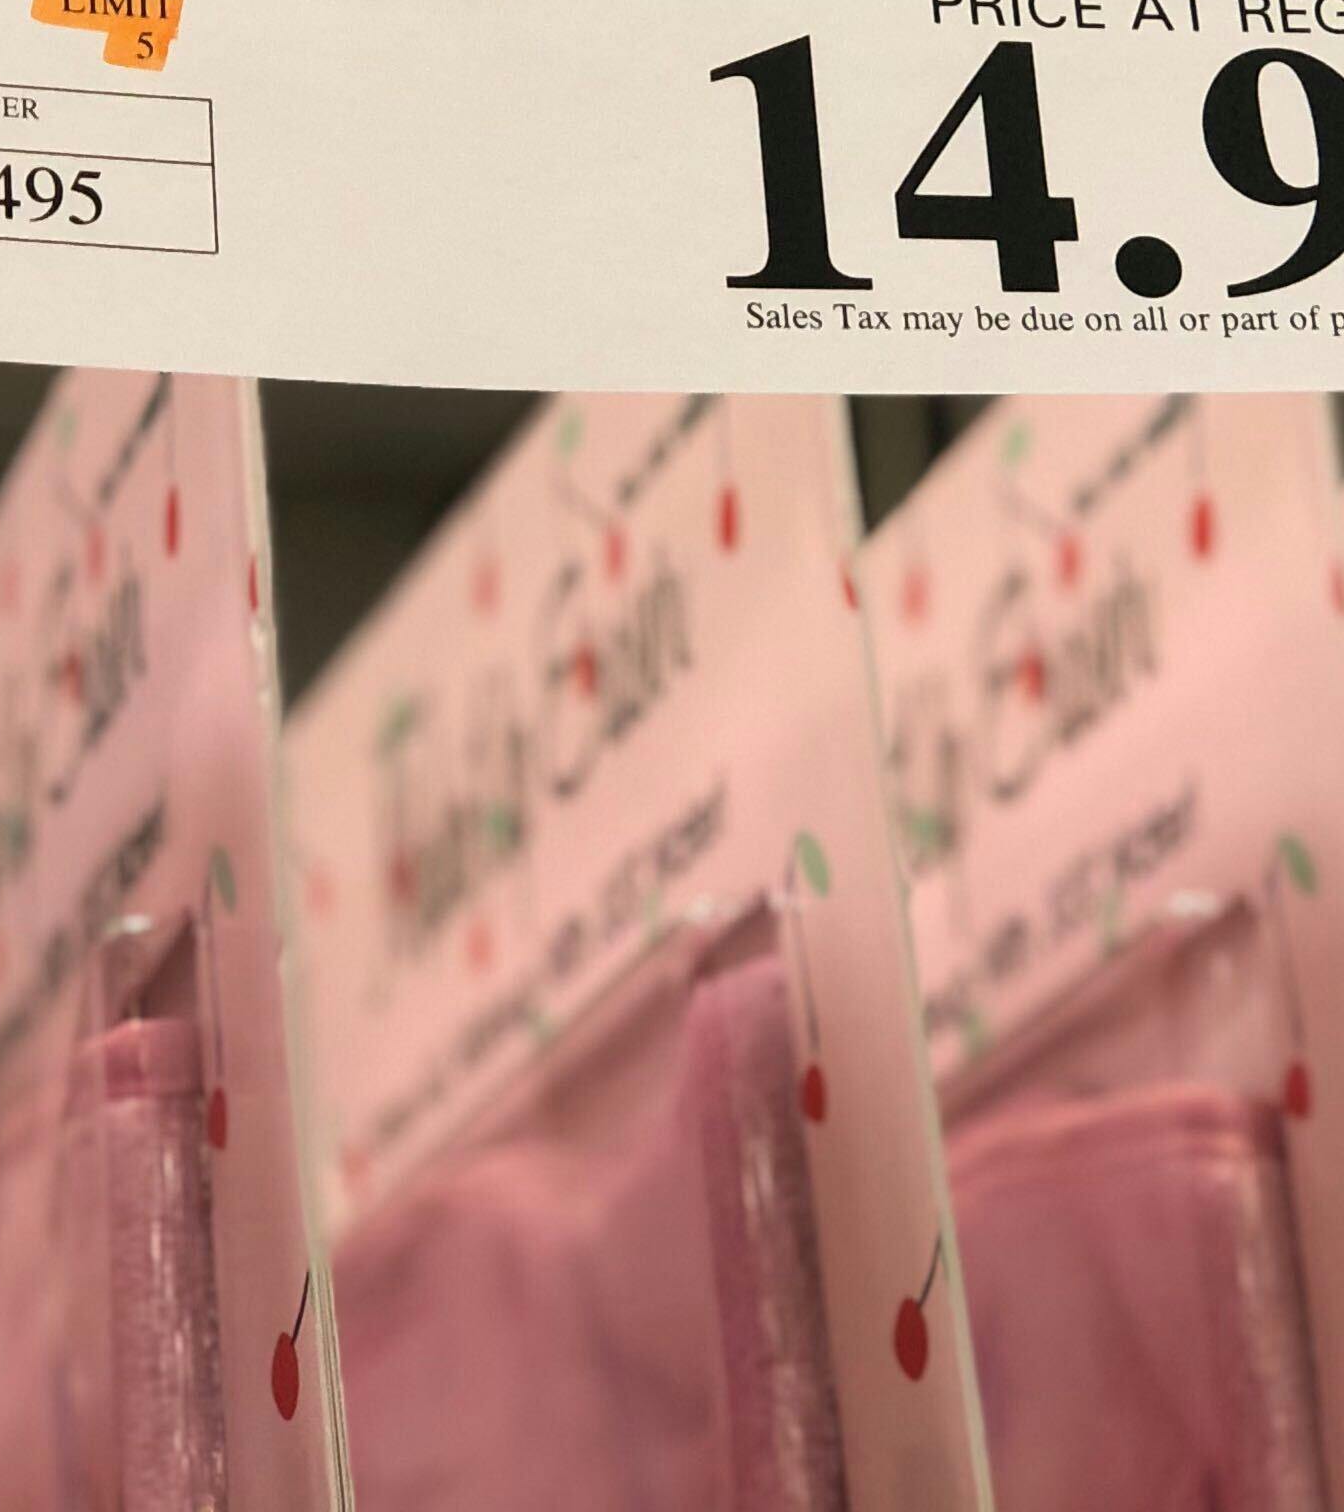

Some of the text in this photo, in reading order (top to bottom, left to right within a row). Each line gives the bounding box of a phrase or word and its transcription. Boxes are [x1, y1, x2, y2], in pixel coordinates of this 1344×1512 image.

[136, 31, 154, 60] 5
[746, 301, 823, 329] Sales
[832, 303, 891, 330] Tax
[903, 311, 963, 338] may
[974, 305, 1010, 331] be
[1021, 305, 1074, 332] due
[1084, 313, 1122, 332] on
[1133, 306, 1168, 331] all
[1179, 313, 1210, 331] or
[1221, 310, 1278, 338] part
[1289, 306, 1319, 331] of
